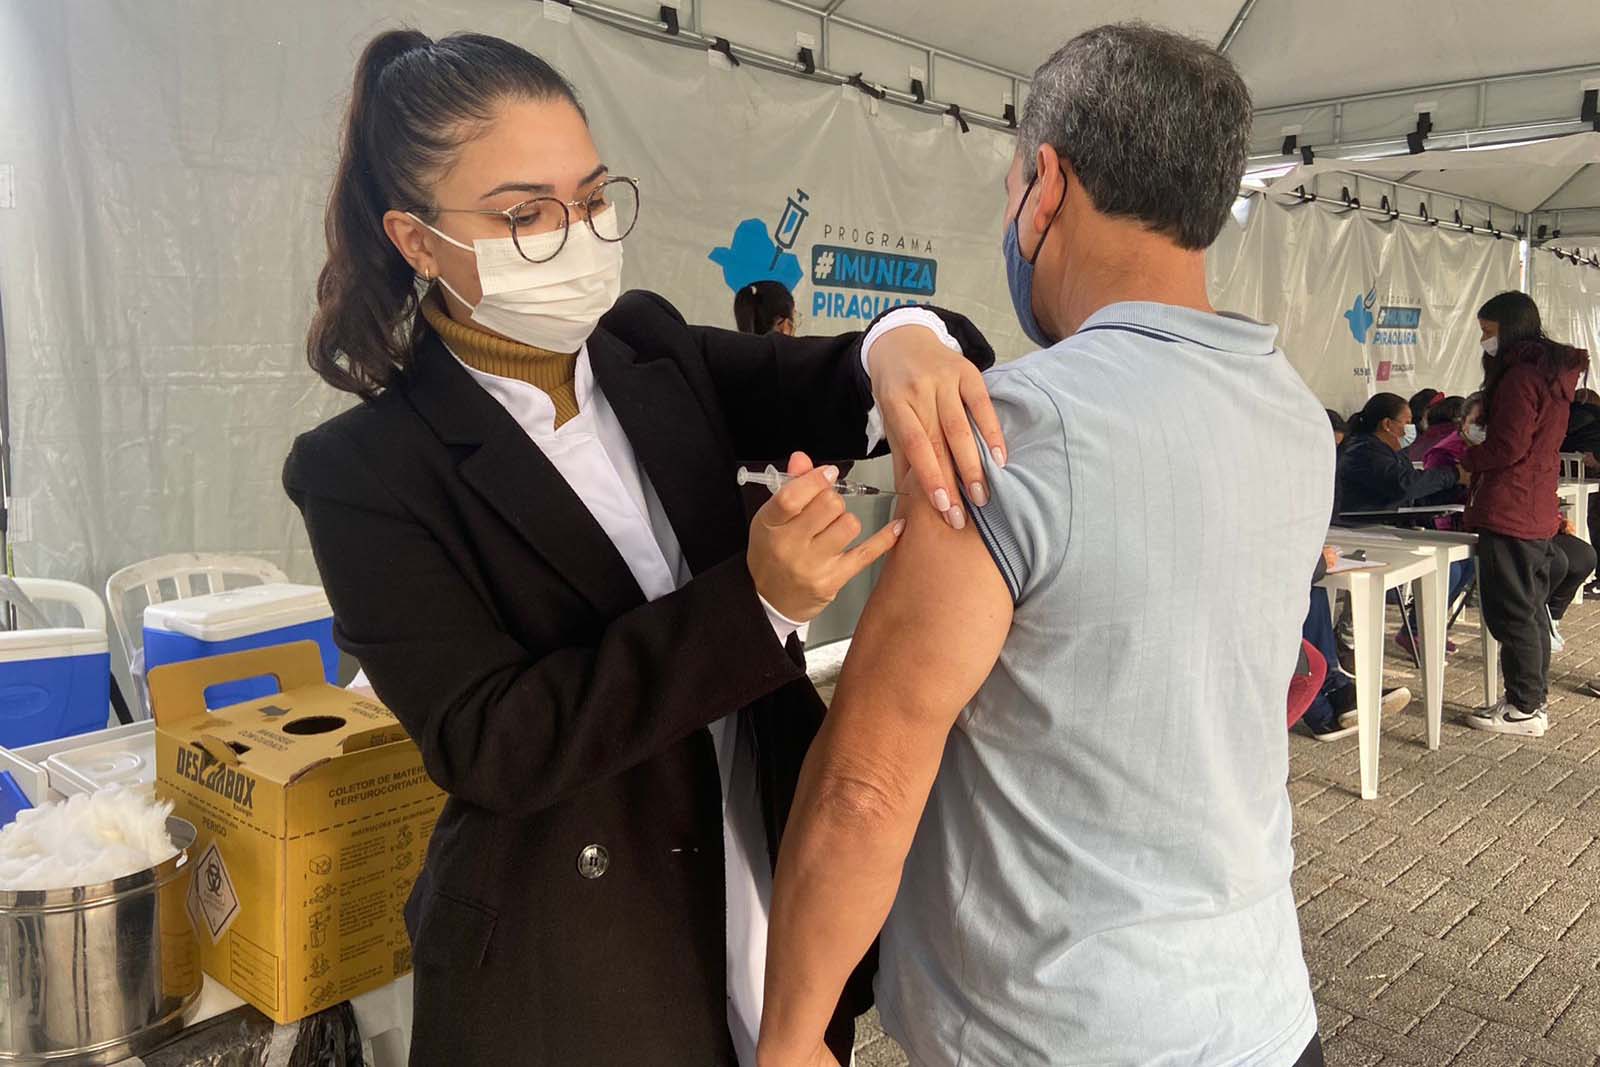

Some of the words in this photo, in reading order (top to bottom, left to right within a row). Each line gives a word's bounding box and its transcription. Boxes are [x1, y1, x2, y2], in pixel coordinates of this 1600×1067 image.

[823, 223, 934, 254] PROGRAMA
[813, 250, 934, 291] #IMUNIZA
[811, 291, 932, 321] PIRAQU
[328, 777, 375, 799] COLETOR
[377, 772, 392, 785] DE
[201, 815, 228, 838] PERIGO
